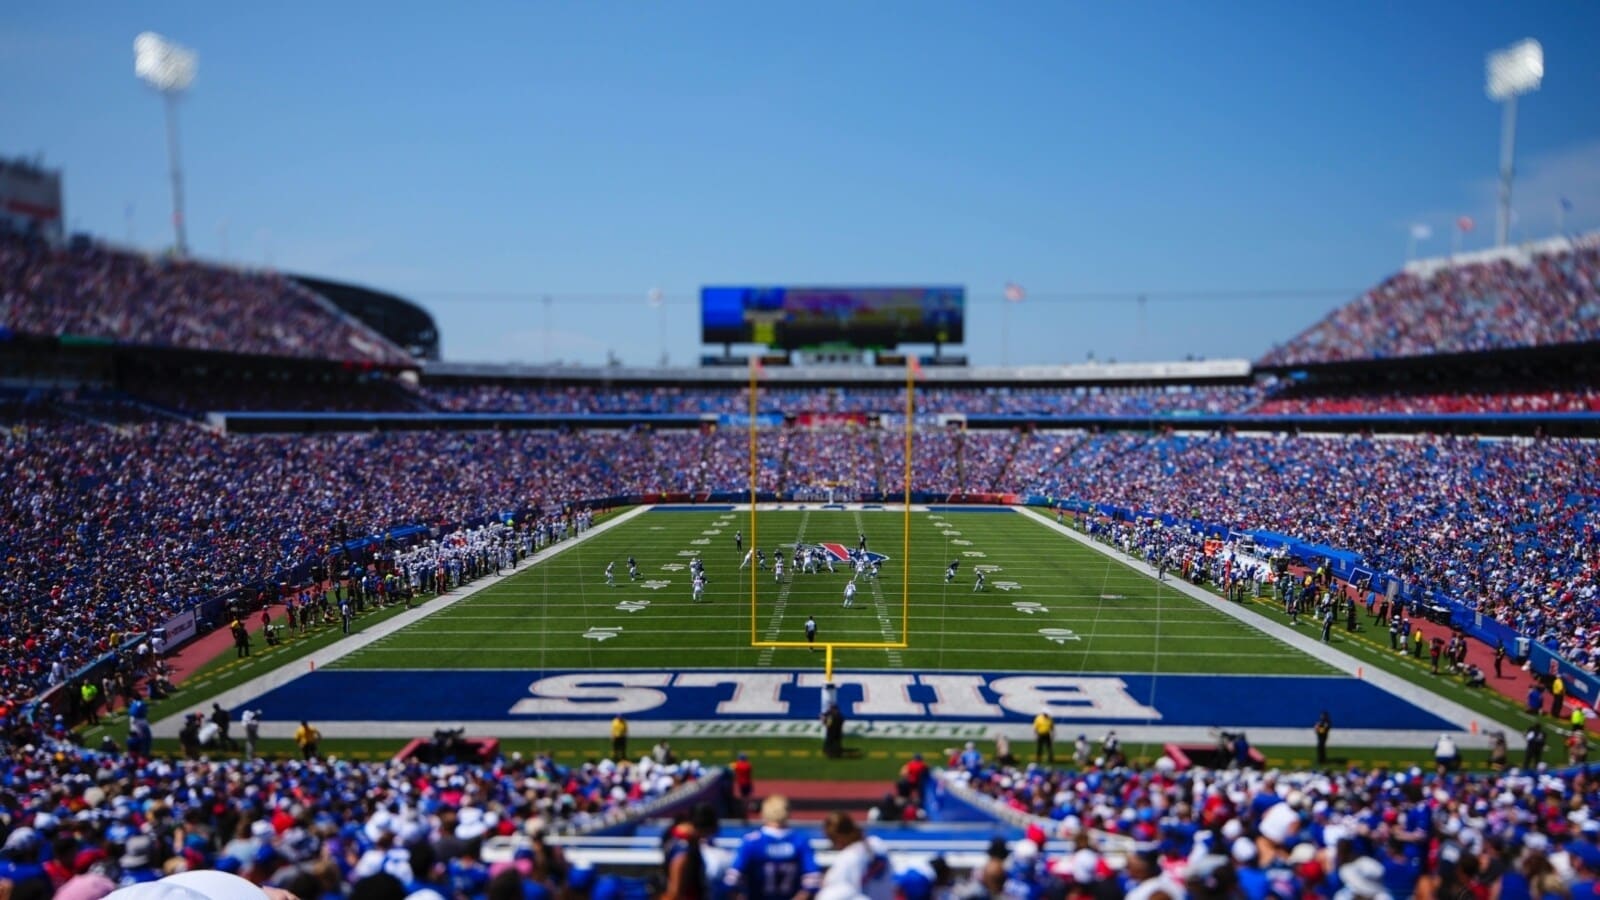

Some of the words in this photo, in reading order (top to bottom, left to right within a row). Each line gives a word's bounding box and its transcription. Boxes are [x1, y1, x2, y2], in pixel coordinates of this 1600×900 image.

[582, 626, 624, 639] 10
[1038, 628, 1081, 642] 10
[508, 673, 1162, 719] BILLS
